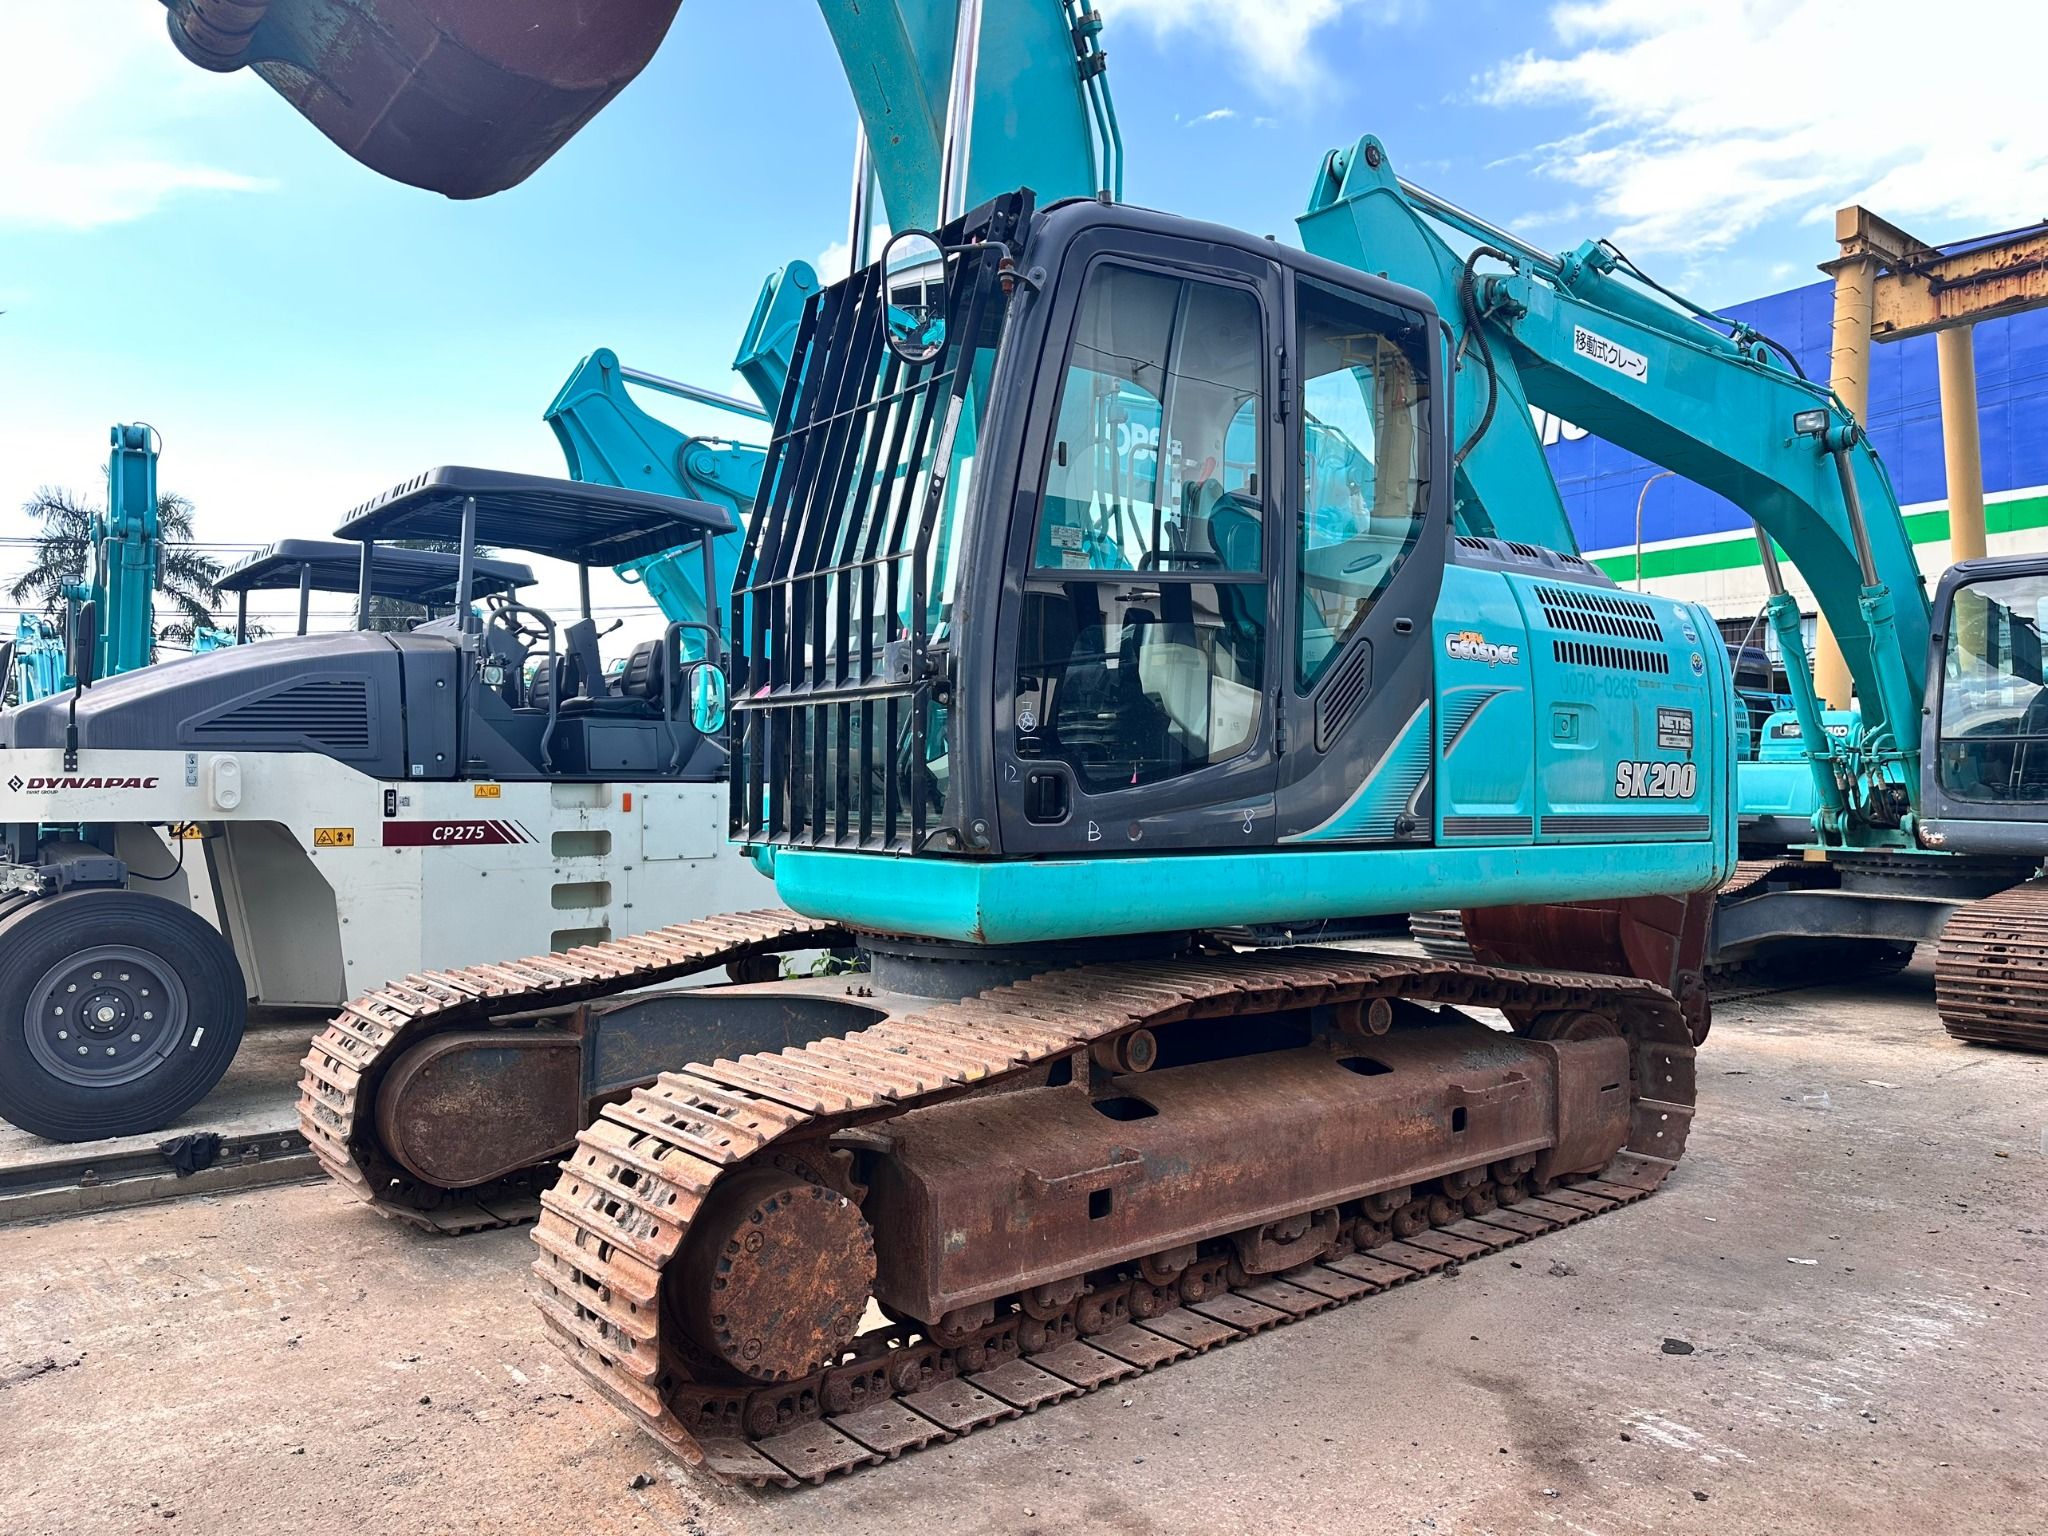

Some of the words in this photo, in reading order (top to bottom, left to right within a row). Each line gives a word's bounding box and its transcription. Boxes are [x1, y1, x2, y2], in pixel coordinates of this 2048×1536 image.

[1575, 329, 1647, 377] 移動式クレーン
[1659, 714, 1692, 731] NETIS
[26, 777, 160, 789] DYNAPAC
[1615, 761, 1698, 799] SK200
[432, 825, 485, 841] CP275
[1088, 820, 1102, 842] B
